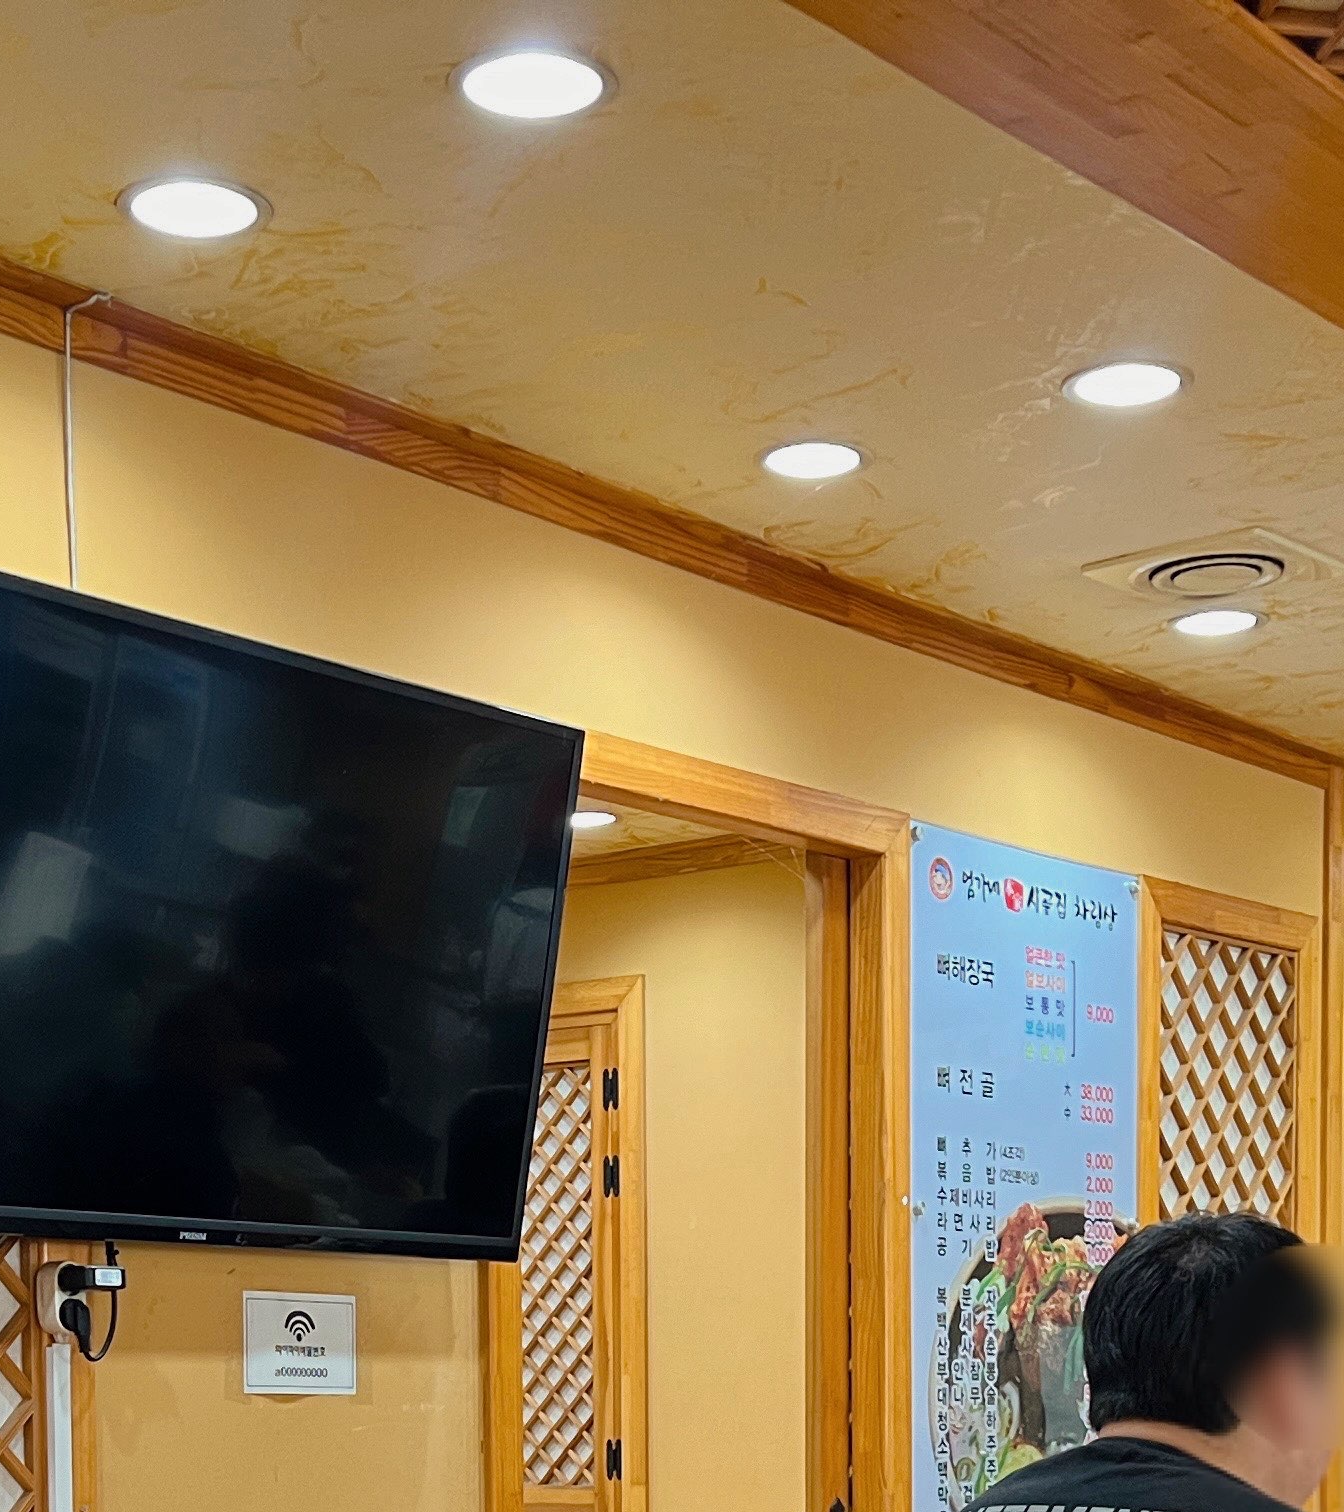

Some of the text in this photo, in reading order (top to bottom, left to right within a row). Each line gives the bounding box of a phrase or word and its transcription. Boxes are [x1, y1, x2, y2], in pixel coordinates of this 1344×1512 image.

[1027, 885, 1067, 919] 시골집
[1074, 895, 1118, 931] 차림상
[937, 953, 995, 989] 뼈해장국
[1086, 1004, 1114, 1024] 9,000
[1081, 1083, 1113, 1103] 38,000
[1080, 1104, 1113, 1124] 33,000
[1086, 1152, 1113, 1171] 9,000
[1086, 1175, 1113, 1194] 2,000
[1086, 1200, 1113, 1219] 2,000
[1086, 1222, 1113, 1241] 2,000
